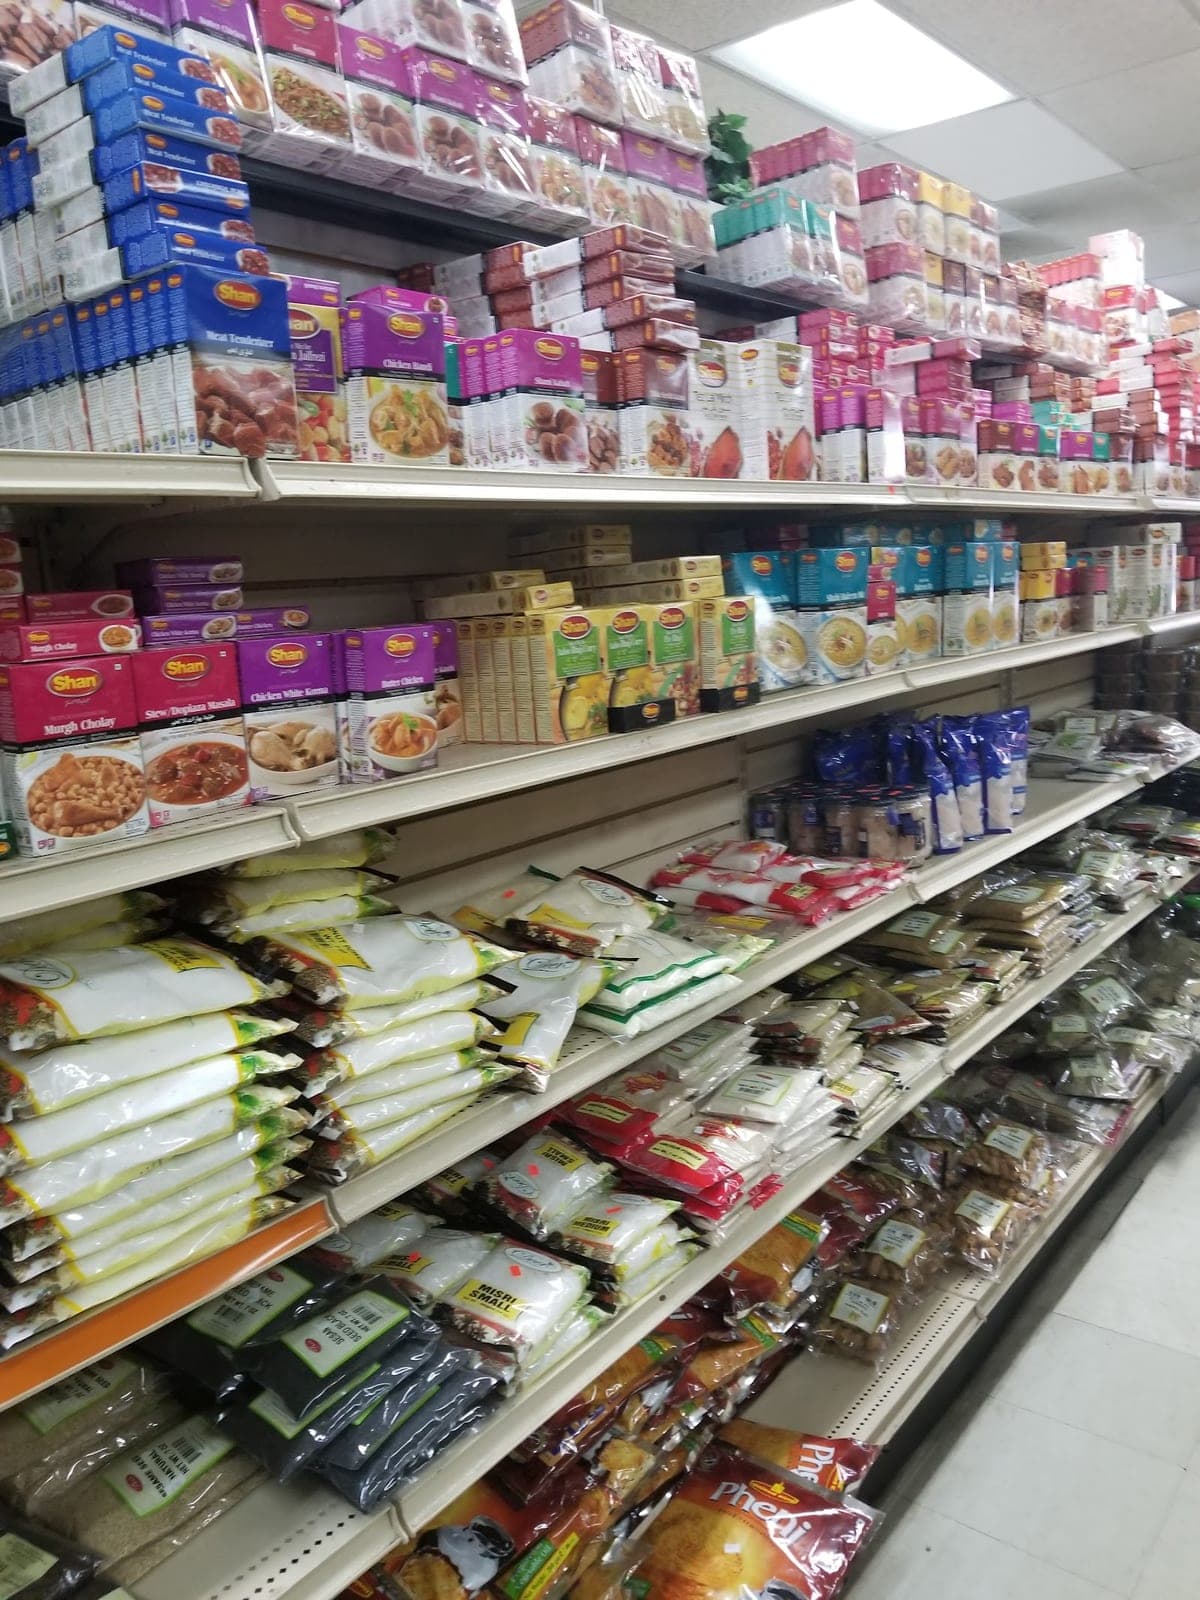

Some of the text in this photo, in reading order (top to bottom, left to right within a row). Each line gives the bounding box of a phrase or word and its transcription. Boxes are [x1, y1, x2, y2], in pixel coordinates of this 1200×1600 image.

[218, 283, 258, 304] Shan
[270, 648, 304, 662] Shan
[166, 660, 205, 676] Shan
[52, 674, 98, 692] Shan
[250, 690, 283, 703] Chicken
[44, 717, 117, 736] Murgh Cholay
[468, 1290, 513, 1313] SMALL
[478, 1283, 519, 1304] MISRI
